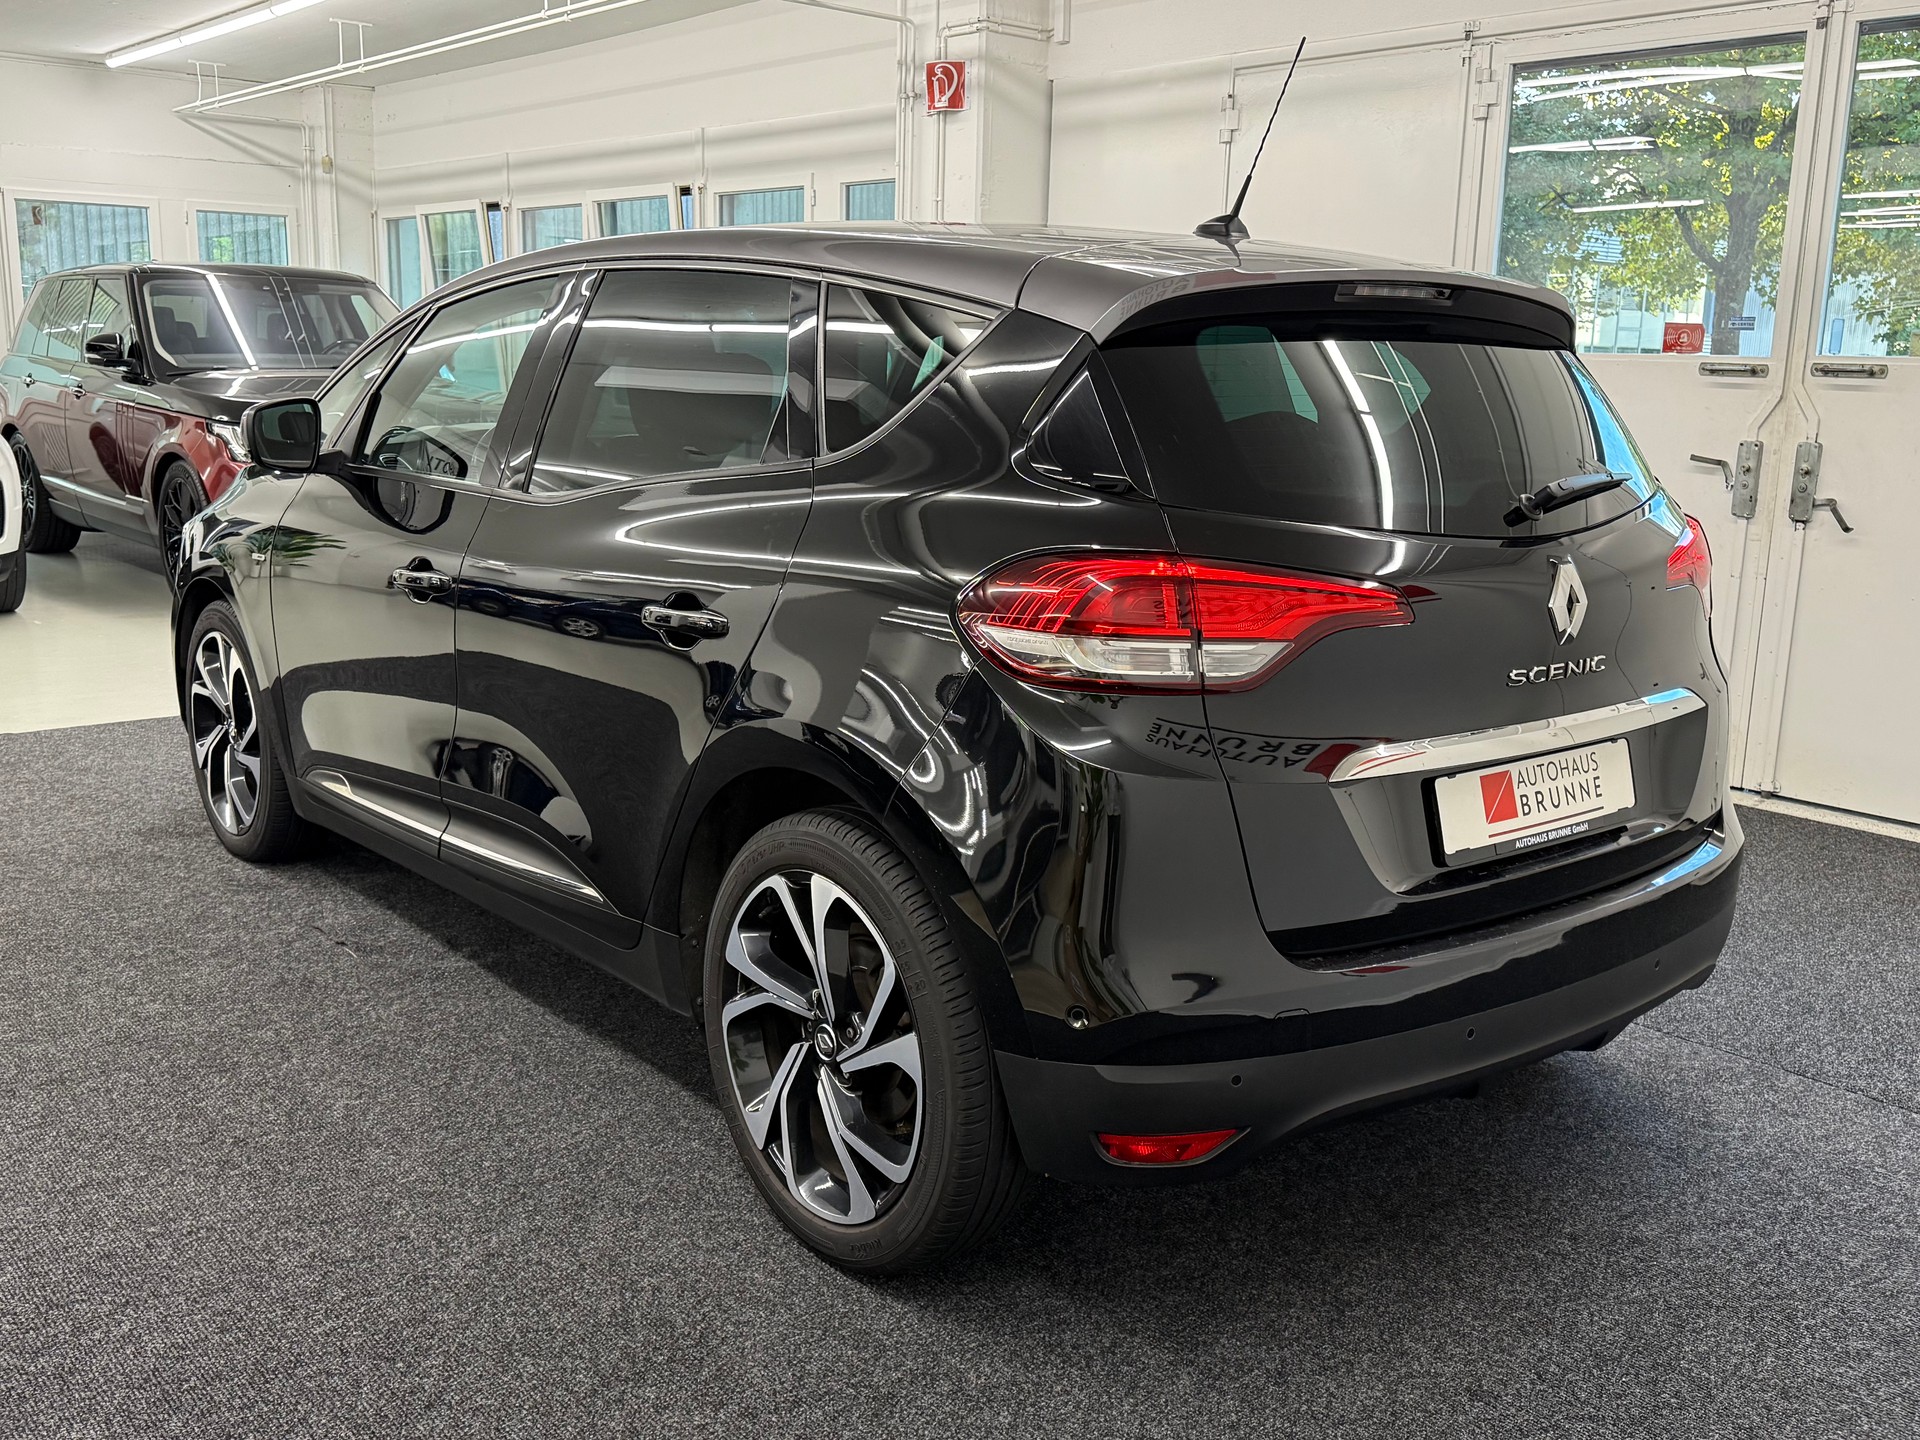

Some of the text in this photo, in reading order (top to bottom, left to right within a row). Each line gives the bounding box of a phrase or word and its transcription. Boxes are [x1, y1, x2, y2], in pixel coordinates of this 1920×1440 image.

[1506, 655, 1606, 687] SCENIC
[1517, 752, 1599, 789] AUTOHAUS
[1519, 775, 1603, 817] BRUNNE
[1515, 821, 1589, 849] AUTOHAUS BRUNNE GmbH
